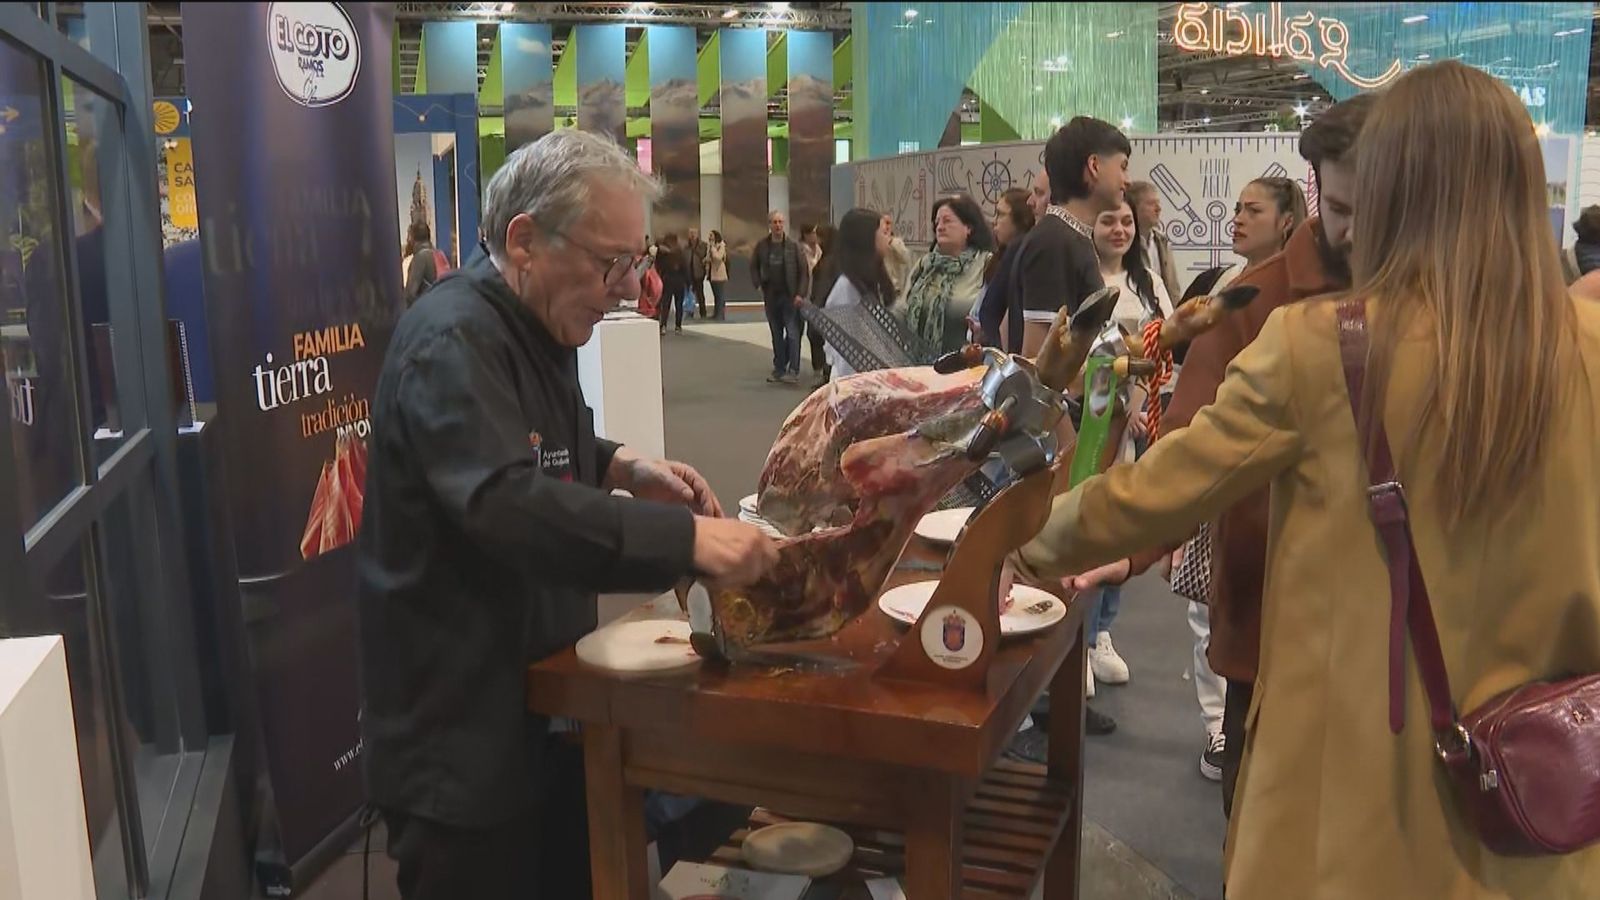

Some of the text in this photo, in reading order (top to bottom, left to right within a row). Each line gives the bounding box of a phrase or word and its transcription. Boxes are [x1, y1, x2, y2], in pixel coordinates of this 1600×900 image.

[276, 14, 349, 61] EL COTO
[174, 162, 194, 174] CA
[175, 176, 195, 188] SA
[293, 322, 365, 361] FAMILIA
[252, 352, 334, 411] tierra
[301, 392, 370, 438] tradición
